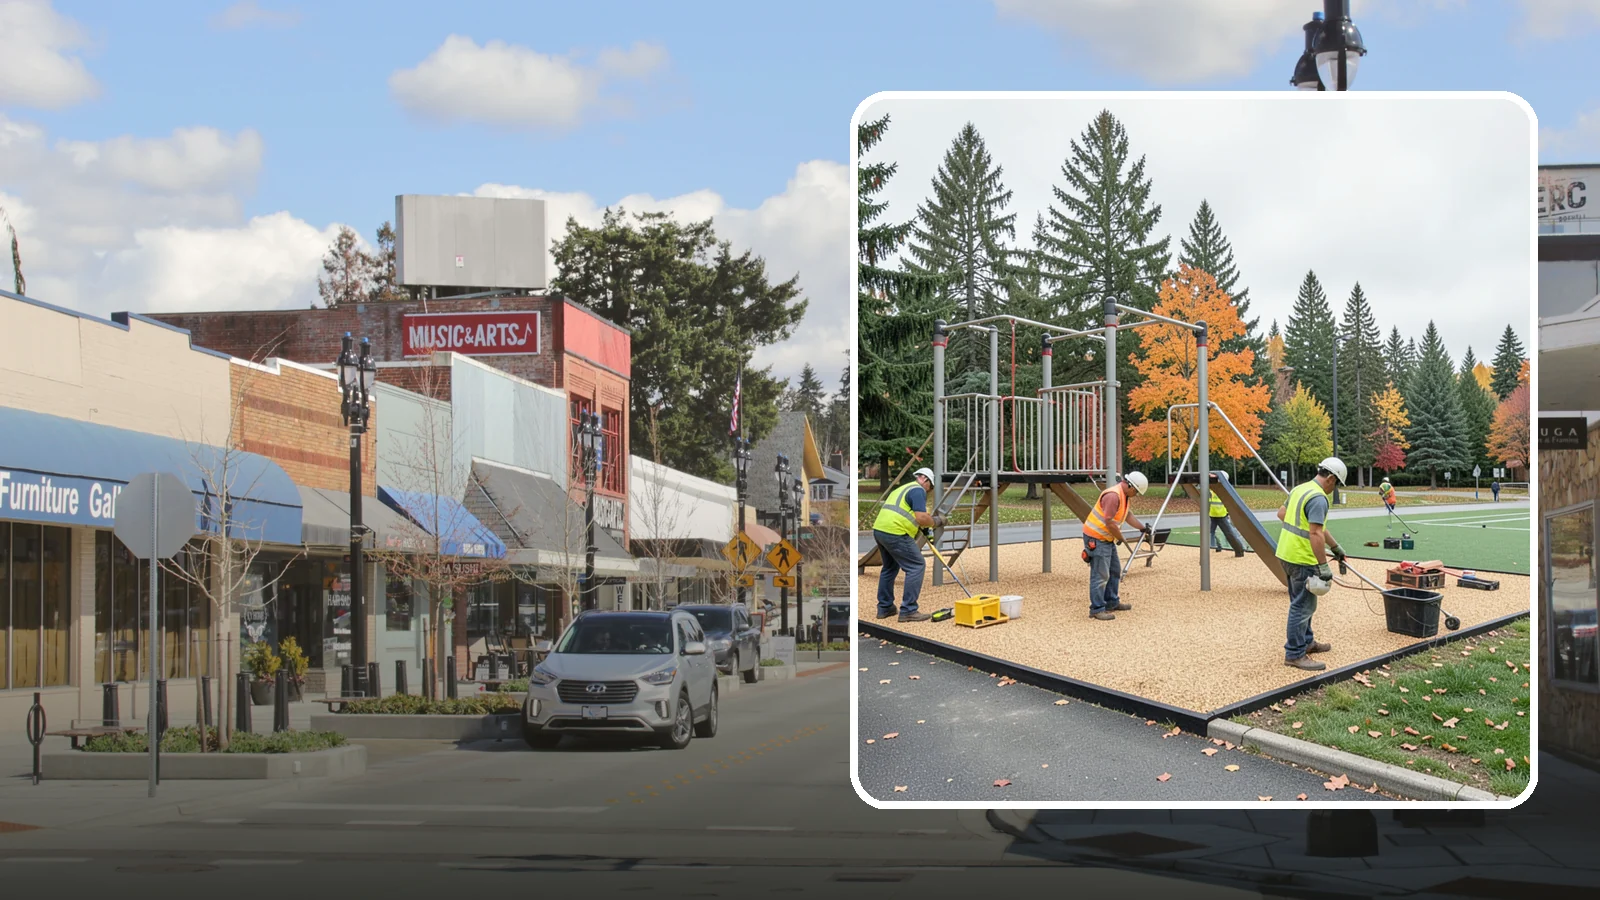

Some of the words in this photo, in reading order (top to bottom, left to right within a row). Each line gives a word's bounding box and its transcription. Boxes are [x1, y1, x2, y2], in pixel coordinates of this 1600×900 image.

[409, 322, 521, 349] MUSIC&ARTS
[1540, 427, 1578, 437] UGA
[0, 471, 79, 515] Furniture
[89, 482, 122, 519] Gal
